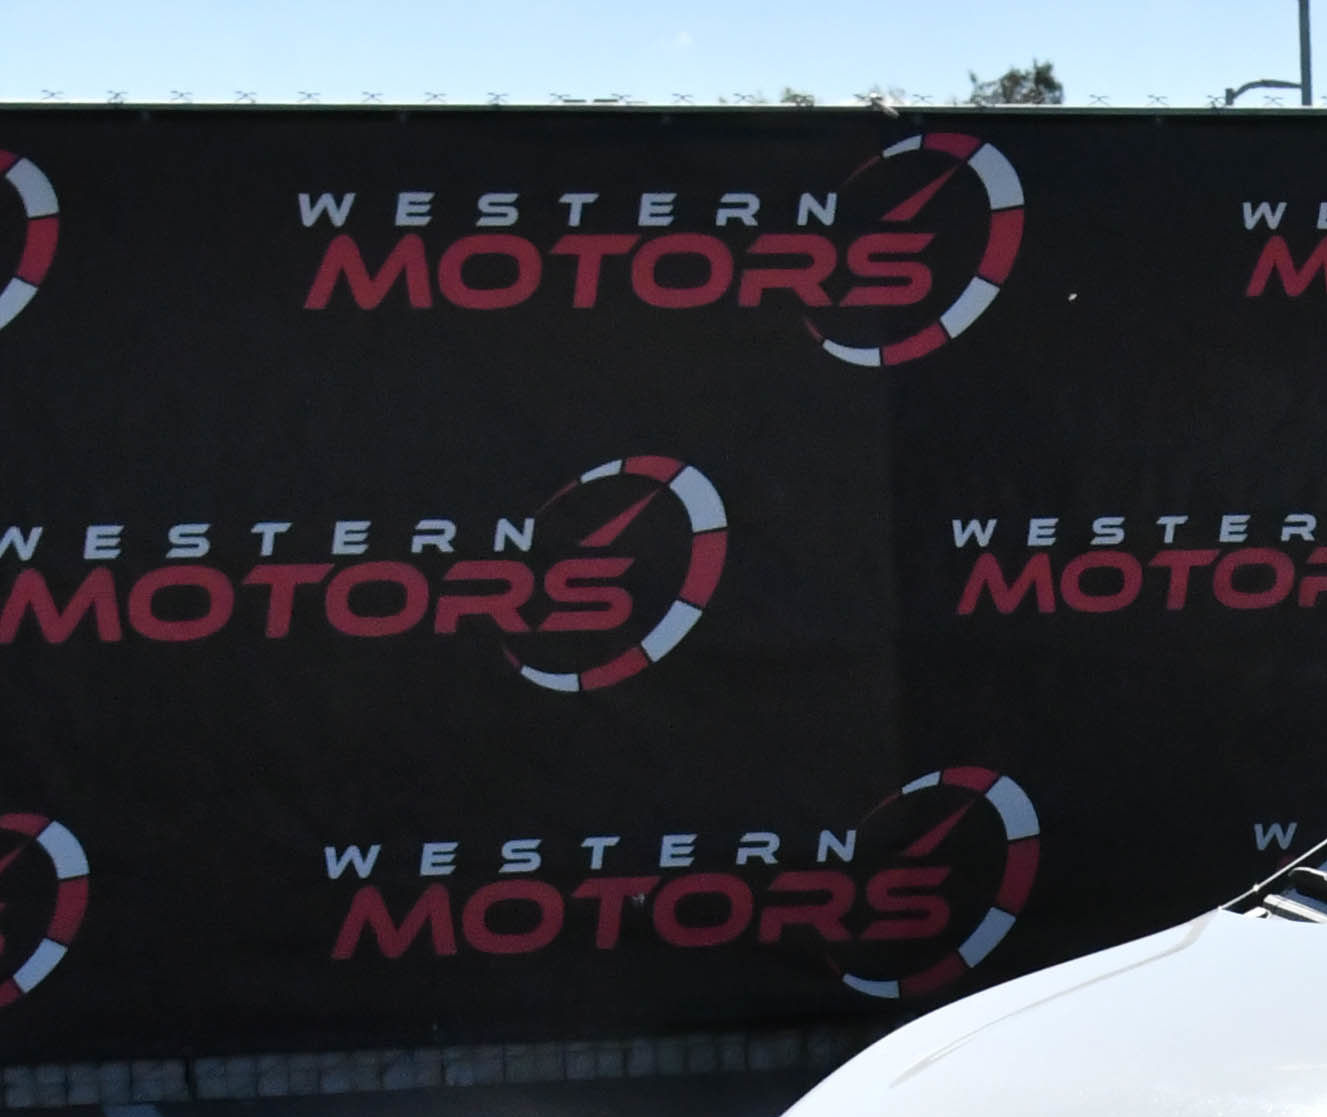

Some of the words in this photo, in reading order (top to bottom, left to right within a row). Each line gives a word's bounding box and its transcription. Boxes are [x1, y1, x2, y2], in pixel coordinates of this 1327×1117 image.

[298, 192, 837, 228] WESTERN
[303, 231, 935, 311] MOTORS
[0, 557, 635, 644] MOTORS
[324, 829, 857, 880] WESTERN
[332, 867, 950, 959] MOTORS
